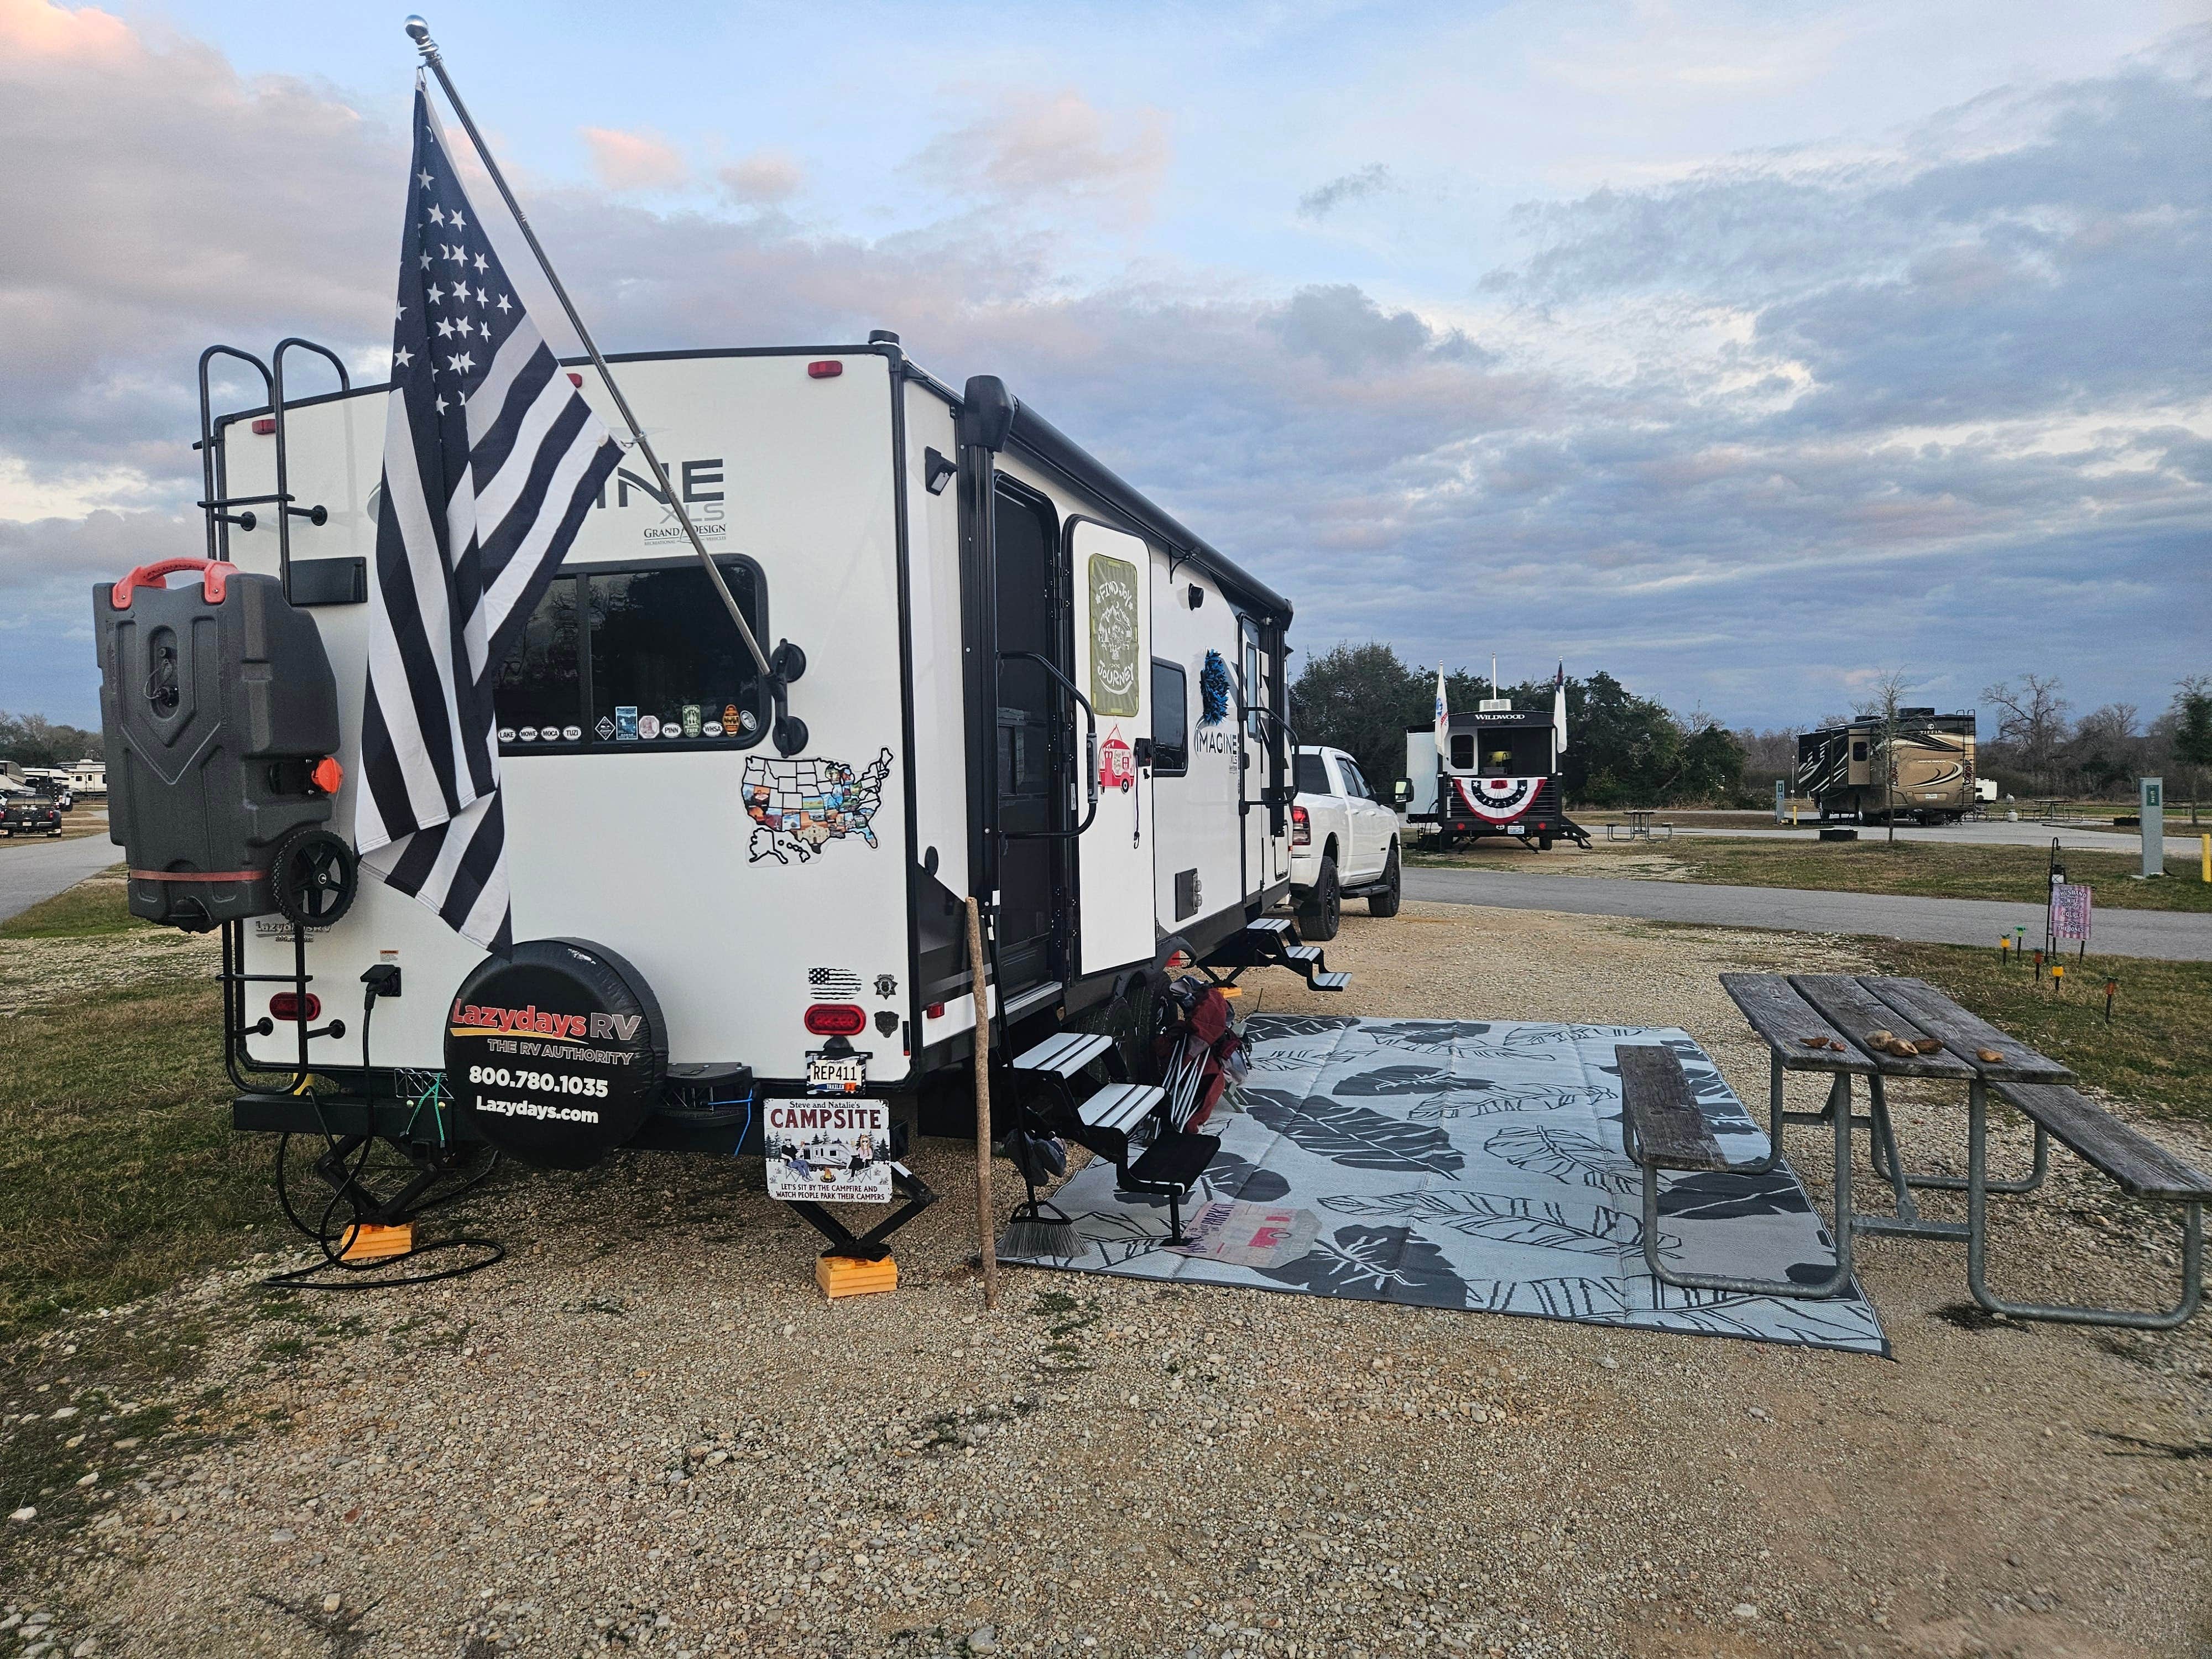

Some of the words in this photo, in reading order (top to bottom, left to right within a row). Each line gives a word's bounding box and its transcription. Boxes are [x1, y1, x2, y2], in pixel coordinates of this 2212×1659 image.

[659, 502, 725, 524] XLS
[644, 528, 680, 538] GRAND
[1098, 581, 1118, 601] FIND
[1196, 729, 1237, 755] IMAGINE
[2060, 890, 2087, 898] HUSBAND
[452, 998, 587, 1038] Lazydays
[589, 1013, 642, 1040] RV
[487, 1039, 518, 1053] THE
[520, 1042, 541, 1056] RV
[542, 1044, 634, 1065] AUTHORITY
[469, 1066, 608, 1098] 800.780.1035
[813, 1066, 857, 1081] REP411
[476, 1095, 599, 1123] Lazydays.com
[770, 1108, 881, 1129] CAMPSITE
